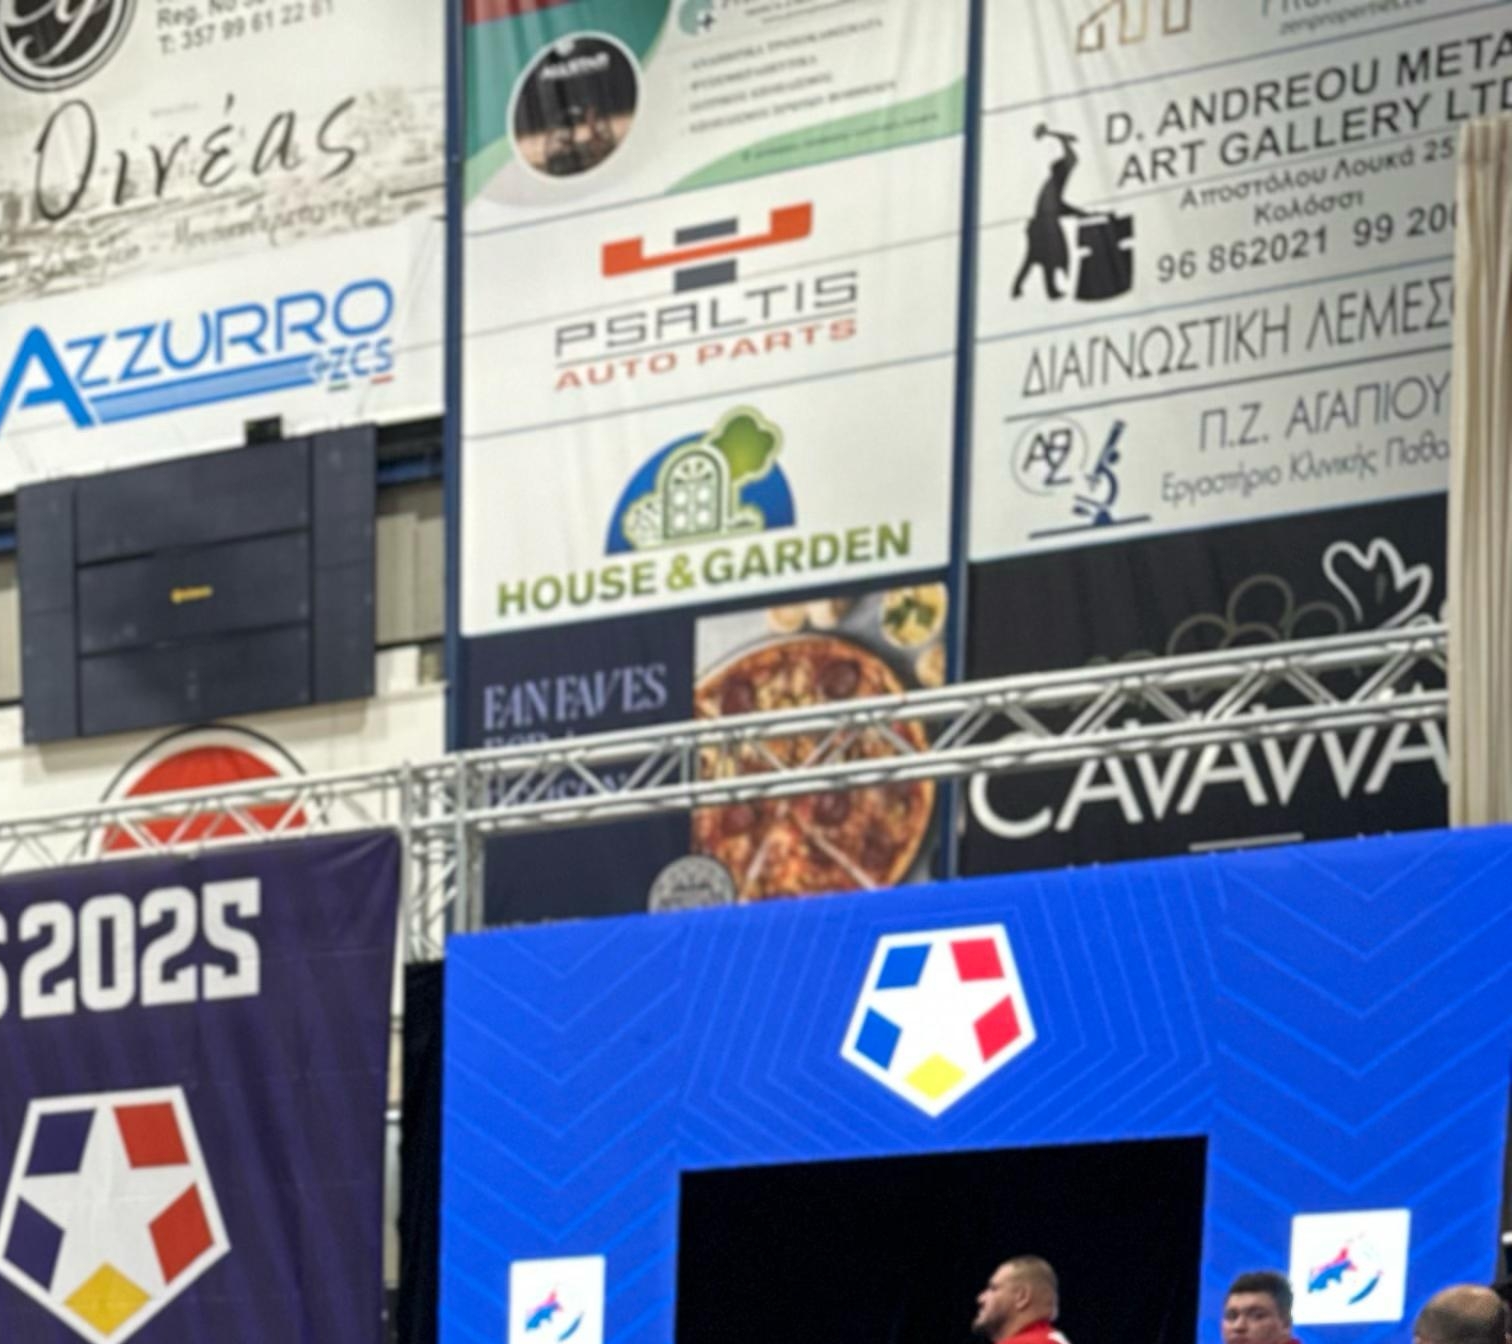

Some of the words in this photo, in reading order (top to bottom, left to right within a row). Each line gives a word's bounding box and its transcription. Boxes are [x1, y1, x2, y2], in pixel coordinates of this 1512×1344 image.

[1105, 113, 1145, 147] D.
[1156, 59, 1381, 137] ANDREOU
[1117, 139, 1206, 190] ART
[1218, 91, 1432, 168] GALLERY
[1179, 165, 1328, 212] Αποστόλου
[1333, 147, 1416, 182] Λουκά
[1422, 136, 1456, 165] 25
[1253, 189, 1366, 227] Κολόσσι
[1157, 248, 1198, 284] 96
[1207, 226, 1329, 276] 862021
[1352, 213, 1395, 248] 99
[1406, 201, 1458, 238] 20
[553, 351, 678, 392] AUTO
[696, 319, 857, 366] PARTS
[554, 270, 858, 357] PSALTIS
[1020, 303, 1290, 399] ΔΙΑΓΝΩΣΤΙΚΗ
[1305, 276, 1457, 350] ΛΕΜΕΣ
[1284, 371, 1452, 440] ΑΓΑΠΙΟΥ
[496, 560, 657, 617] HOUSE
[665, 562, 695, 593] &
[701, 521, 913, 588] GARDEN
